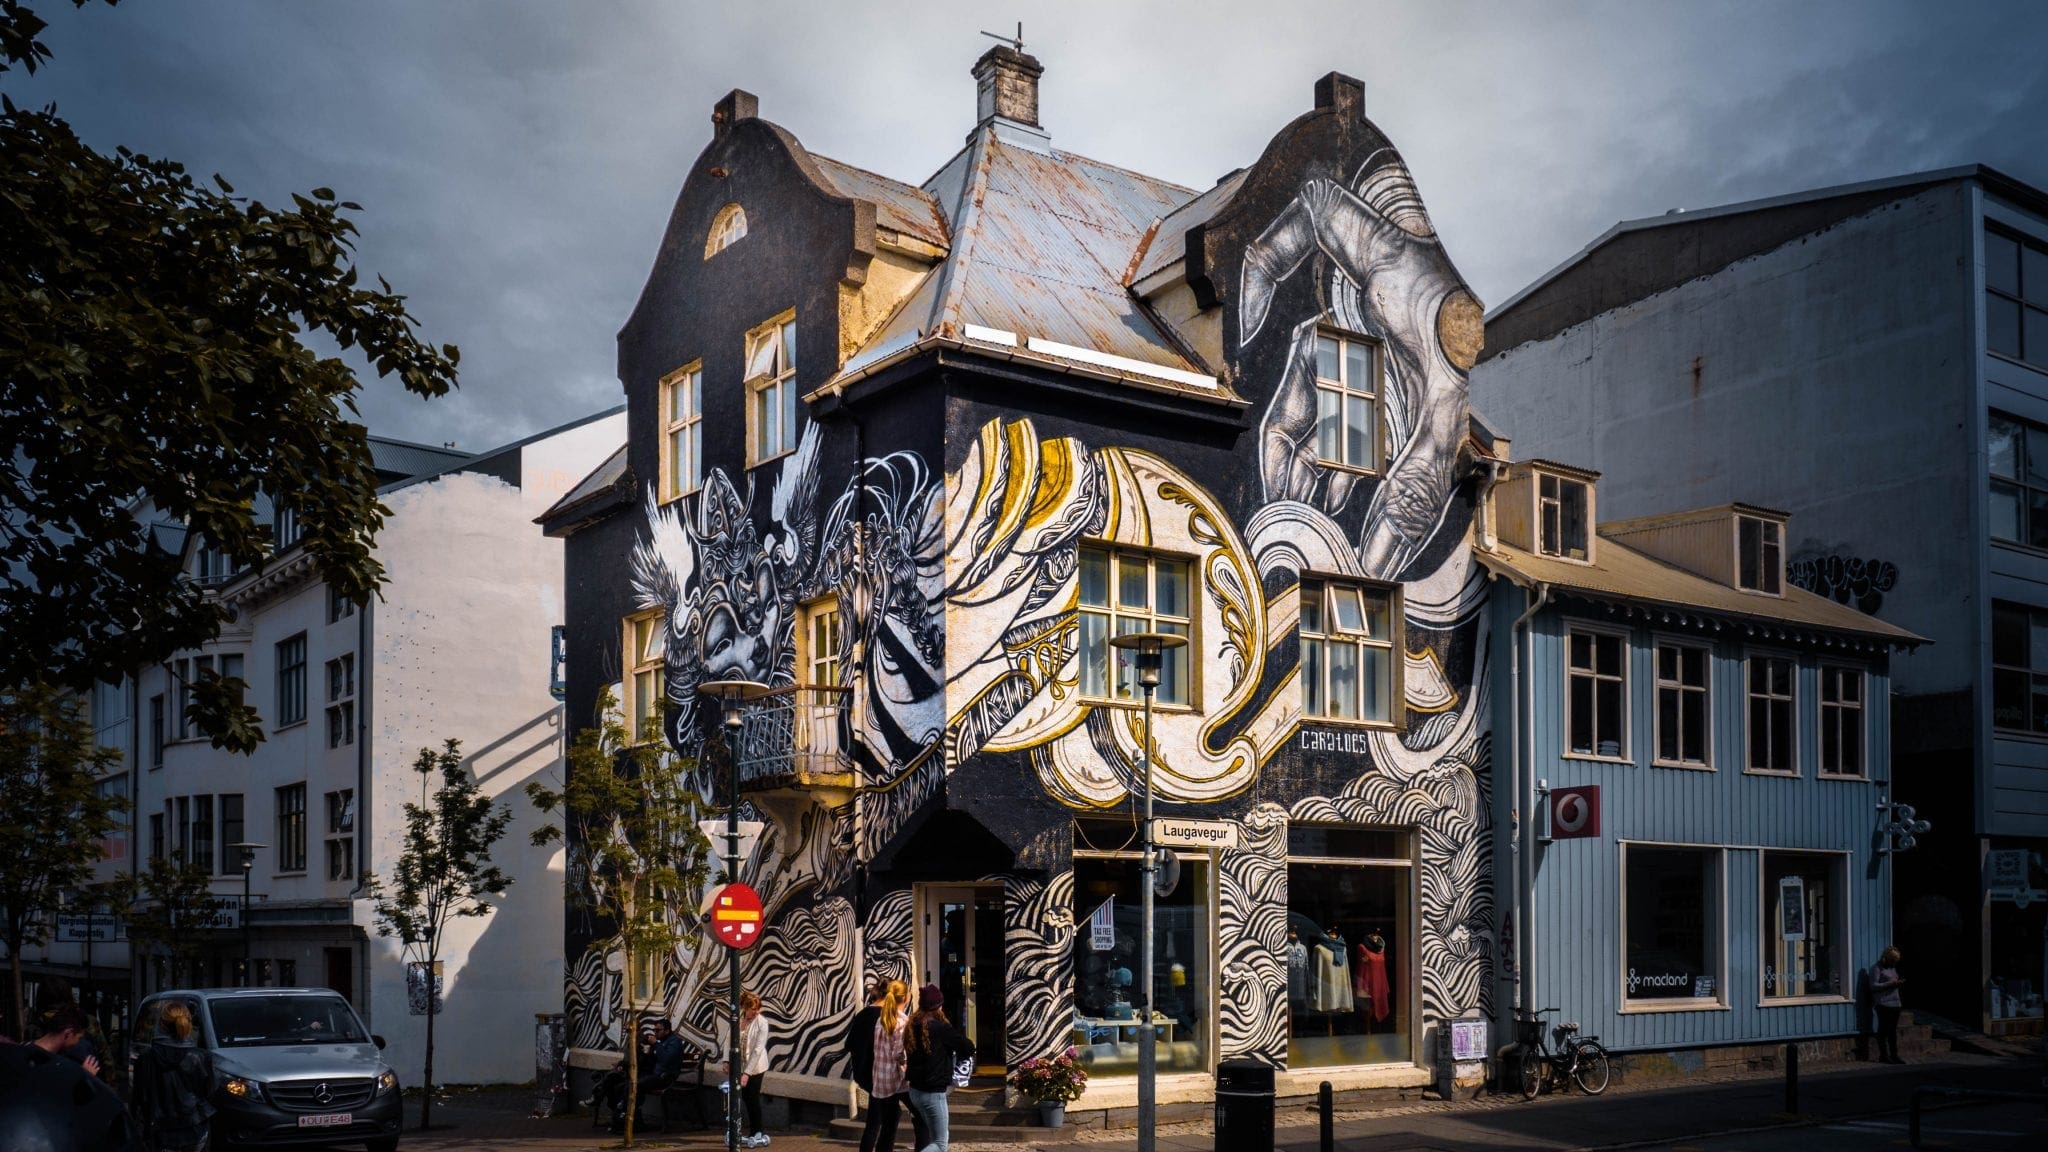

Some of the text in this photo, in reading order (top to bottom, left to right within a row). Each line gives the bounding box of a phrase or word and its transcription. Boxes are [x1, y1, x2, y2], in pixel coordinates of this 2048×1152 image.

[1163, 824, 1228, 841] Laugavegur
[1102, 927, 1111, 935] FREE
[1642, 972, 1688, 987] macland
